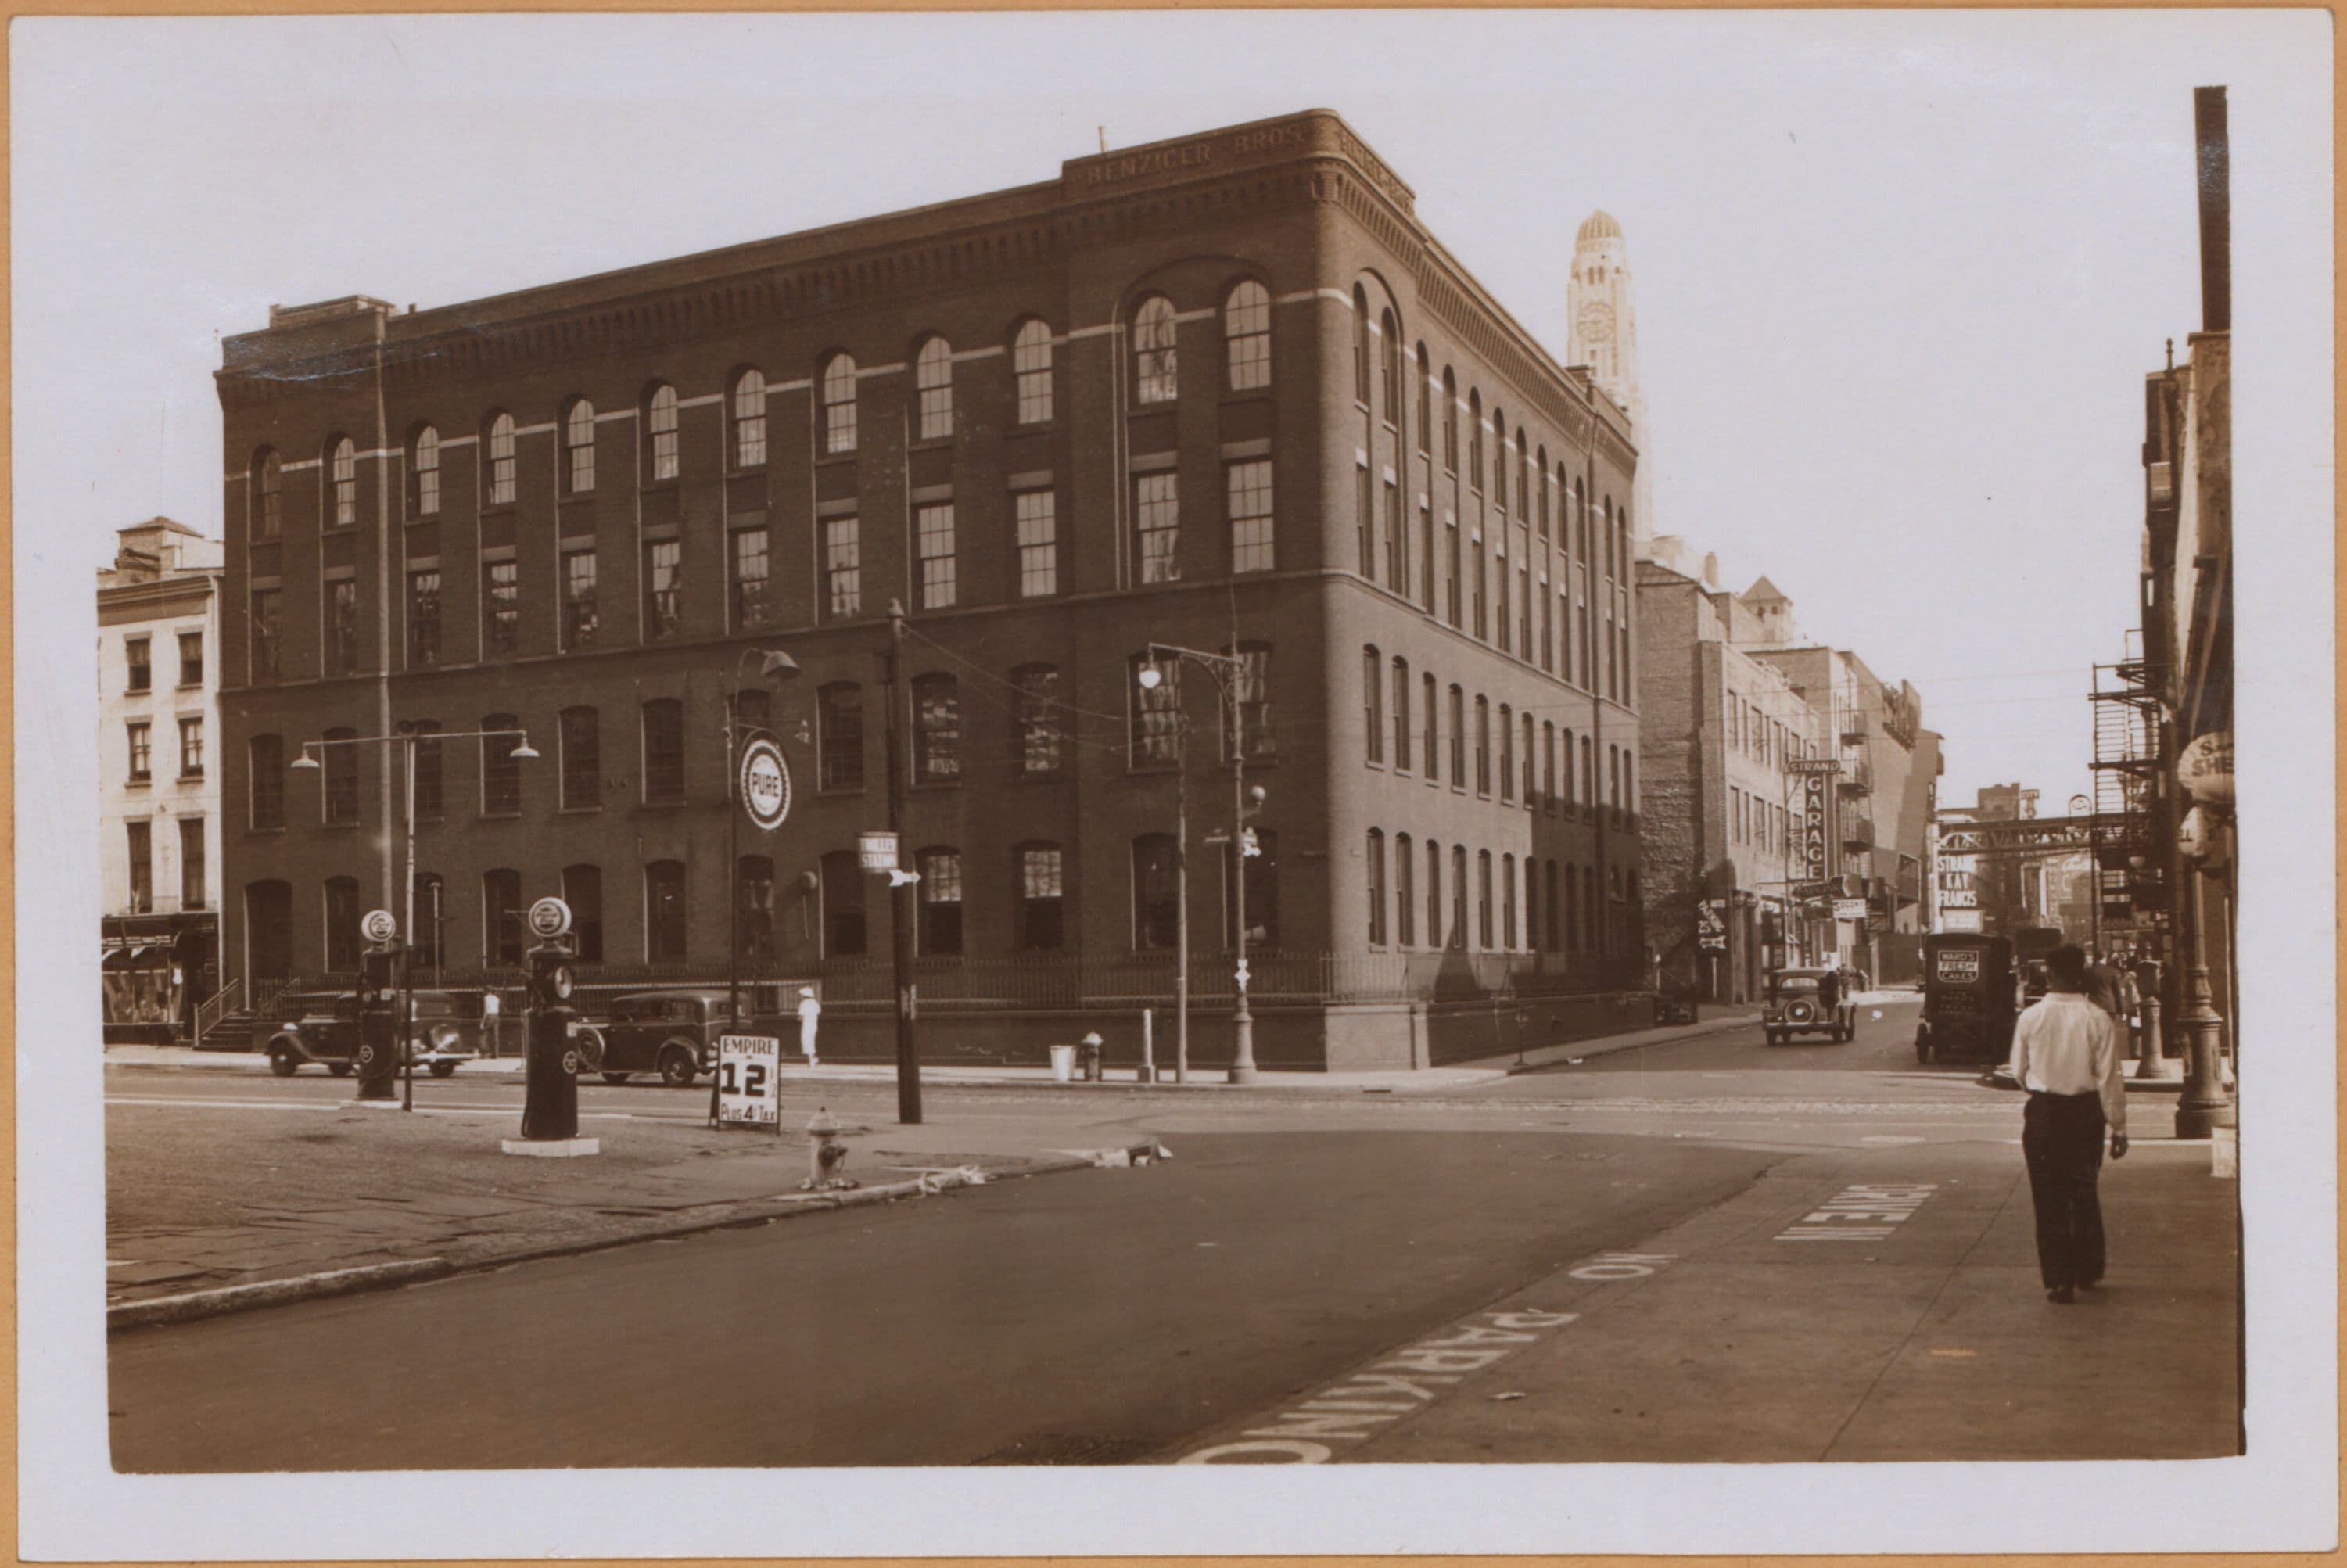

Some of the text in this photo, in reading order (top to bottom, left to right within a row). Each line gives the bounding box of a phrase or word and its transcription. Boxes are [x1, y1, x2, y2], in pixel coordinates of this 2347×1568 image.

[1789, 762, 1839, 772] STRAND
[752, 771, 779, 798] PURE
[1807, 777, 1823, 879] GARAGE
[1946, 873, 1969, 889] KAY
[723, 1037, 775, 1055] EMPIRE
[1568, 1253, 1679, 1279] NO
